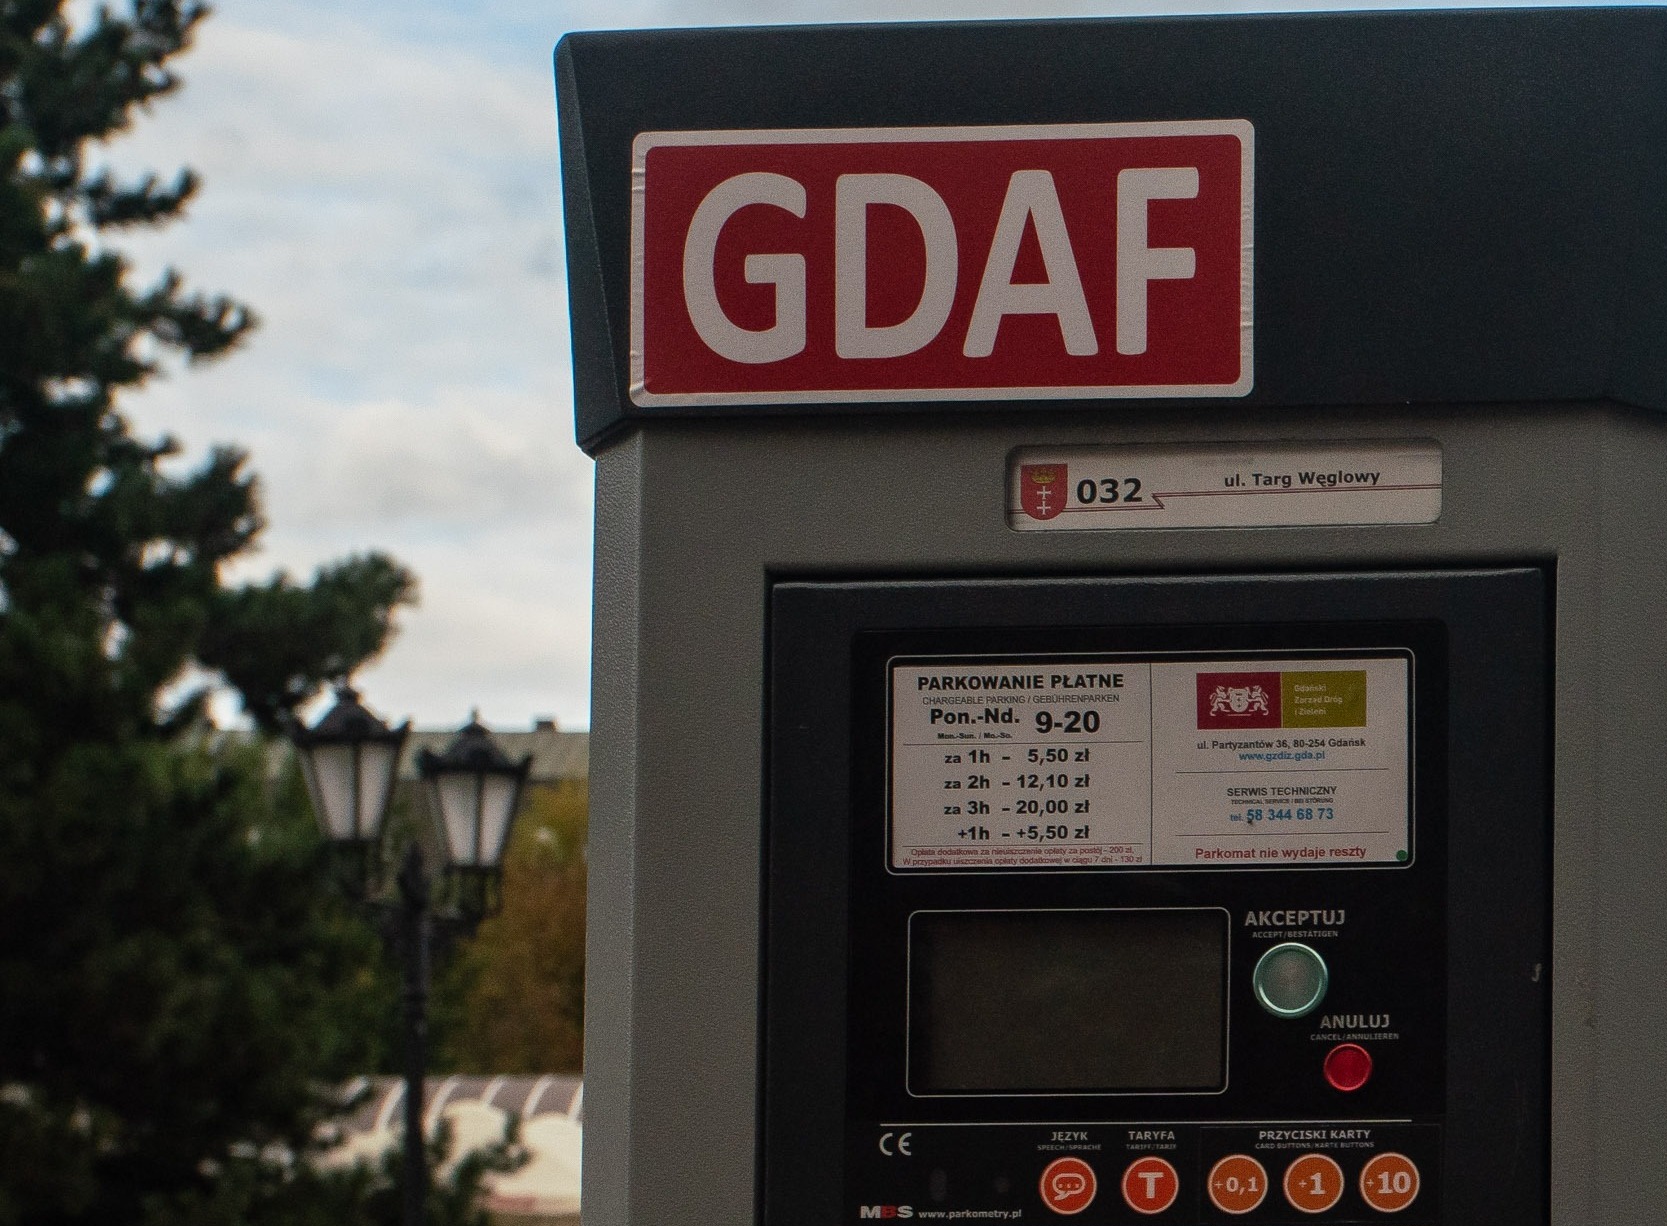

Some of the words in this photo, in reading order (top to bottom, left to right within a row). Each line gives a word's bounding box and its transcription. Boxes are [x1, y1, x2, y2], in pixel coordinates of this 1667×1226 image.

[683, 167, 1199, 365] GDAF
[1224, 470, 1245, 488] ul.
[1252, 472, 1292, 489] Targ
[1298, 470, 1380, 486] Węglowy
[1076, 477, 1143, 505] 032
[918, 675, 1044, 691] PARKOWANIE
[1051, 674, 1124, 688] PŁATNE
[922, 696, 983, 705] CHARGEABLE
[986, 695, 1025, 704] PARKING
[1032, 694, 1120, 703] GEBÜHRENPARKEN
[930, 708, 1020, 725] Pon.-Nd.
[1035, 710, 1100, 733] 9-20
[1212, 740, 1274, 750] Partyzantów
[1276, 739, 1290, 749] 36,
[1293, 739, 1325, 748] 80-254
[1328, 738, 1365, 747] Gdańsk
[944, 754, 961, 764] za
[968, 750, 990, 764] 1h
[1028, 748, 1068, 765] 5,50
[1075, 748, 1090, 762] zł
[1239, 751, 1325, 761] www.gzdiz.gda.pl
[944, 779, 961, 789] za
[968, 775, 990, 789] 2h
[1017, 774, 1068, 790] 12,10
[1075, 774, 1090, 787] zł
[1227, 788, 1267, 797] SERWIS
[1271, 786, 1337, 795] TECHNICZNY
[944, 805, 961, 815] za
[968, 801, 990, 815] 3h
[1016, 800, 1068, 816] 20,00
[1075, 800, 1090, 814] zł
[1247, 809, 1263, 821] 58
[1268, 809, 1292, 820] 344
[1297, 809, 1313, 820] 68
[1318, 808, 1333, 819] 73
[958, 827, 990, 841] +1h
[1017, 825, 1068, 842] +5,50
[1075, 825, 1090, 839] zł
[1195, 848, 1255, 859] Parkomat
[1259, 848, 1278, 857] nie
[1282, 847, 1325, 859] wydaje
[1330, 847, 1366, 858] reszty
[1244, 910, 1345, 926] AKCEPTUJ
[1320, 1014, 1390, 1029] ANULUJ
[1051, 1131, 1089, 1142] JĘZYK
[1128, 1131, 1176, 1140] TARYFA
[1259, 1130, 1326, 1141] PRZYCISKI
[1331, 1129, 1371, 1140] KARTY
[1139, 1172, 1163, 1199] T
[860, 1205, 914, 1219] MBS
[918, 1209, 1022, 1219] www.parkometry.pl
